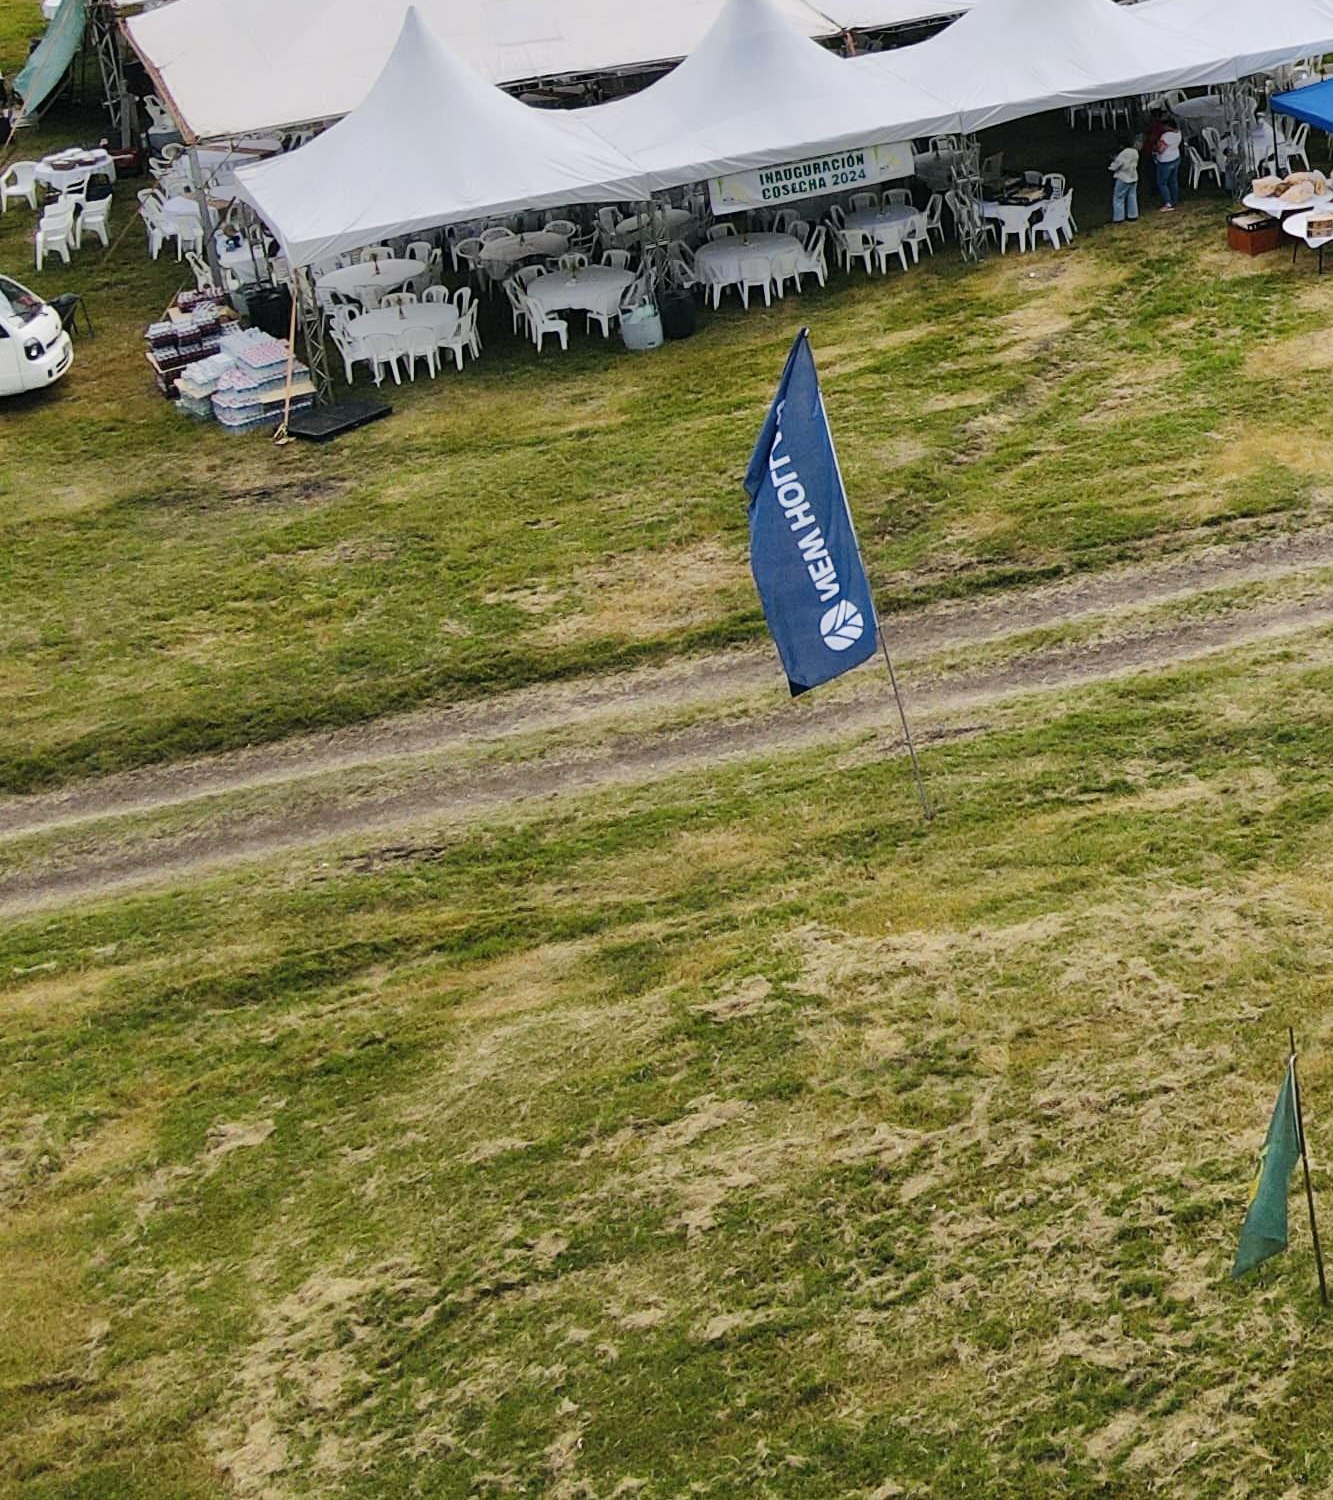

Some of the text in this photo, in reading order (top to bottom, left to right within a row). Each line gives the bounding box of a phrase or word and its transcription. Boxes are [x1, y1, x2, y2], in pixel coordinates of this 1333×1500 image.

[759, 153, 865, 186] INAUGURACIÓN
[762, 168, 867, 200] COSECHA 2024
